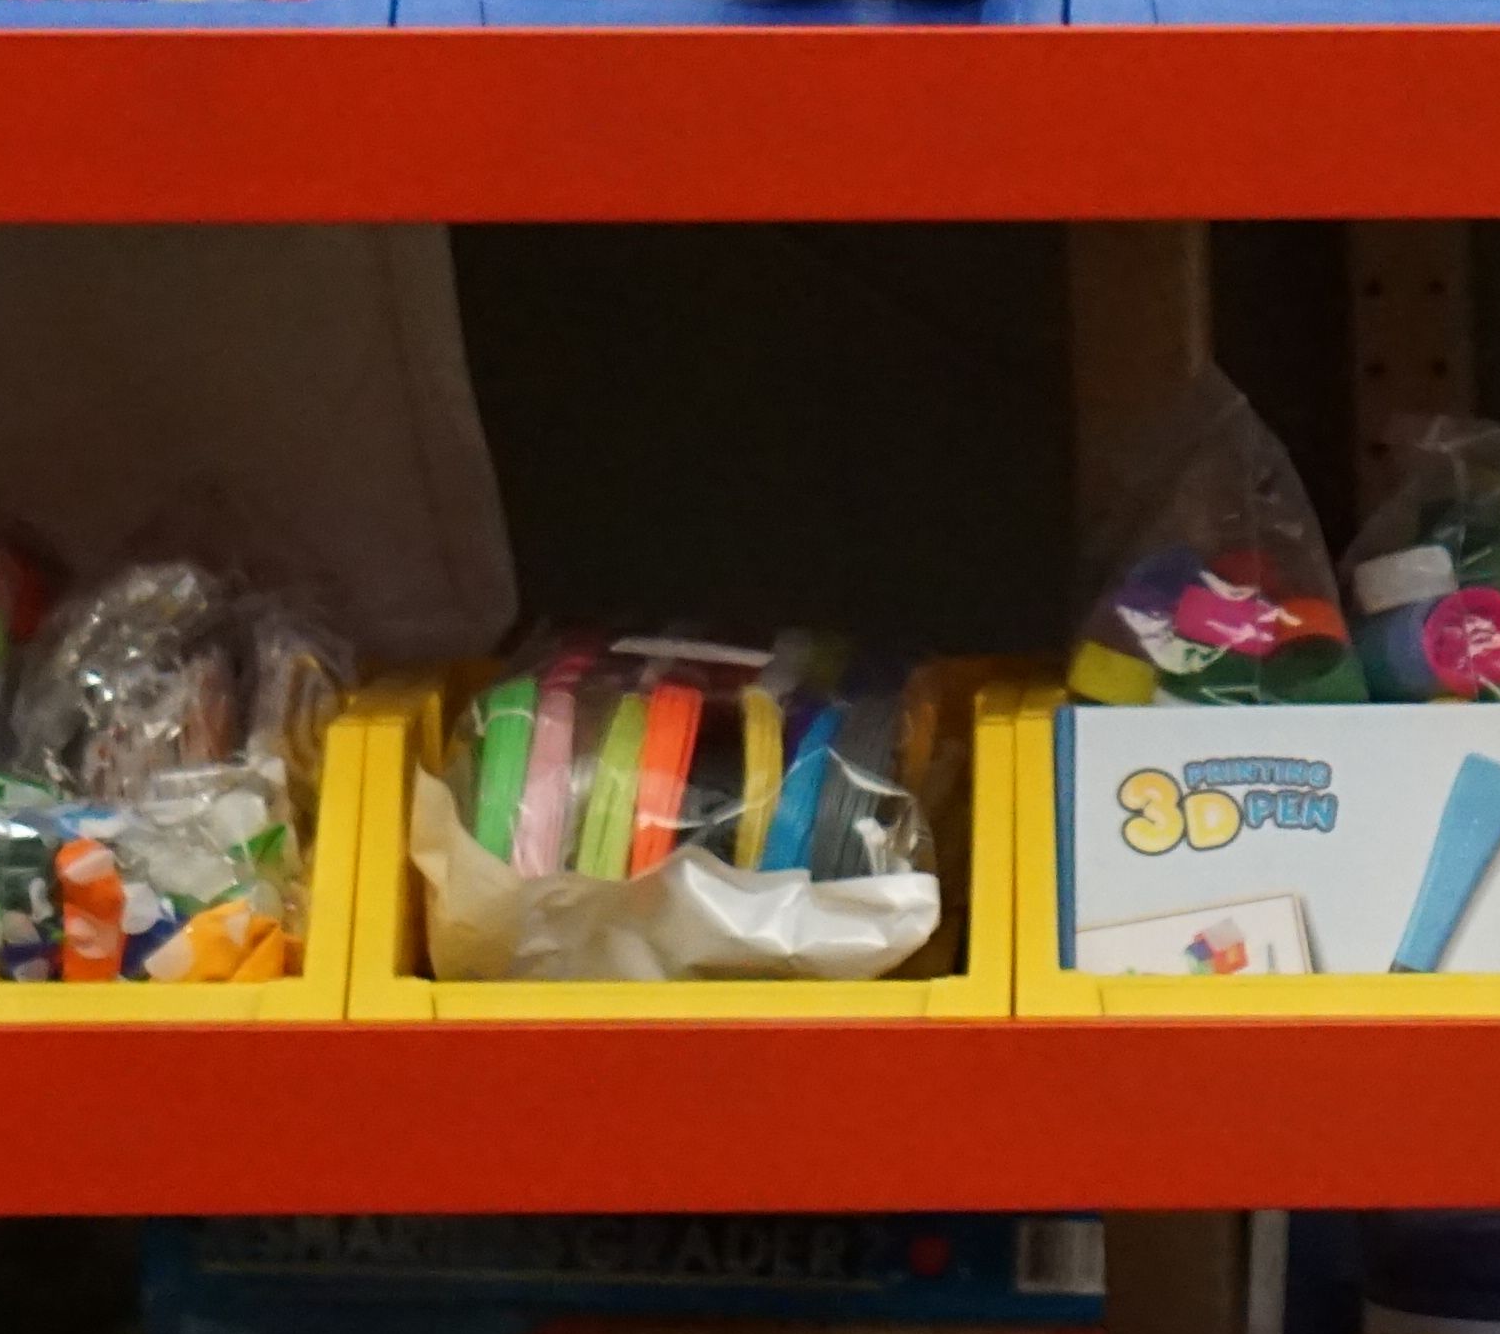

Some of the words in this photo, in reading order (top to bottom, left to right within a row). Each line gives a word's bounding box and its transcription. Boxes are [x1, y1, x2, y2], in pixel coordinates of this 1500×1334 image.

[1182, 756, 1333, 790] PRINTING
[1117, 767, 1243, 856] 3D
[1244, 789, 1339, 833] PEN
